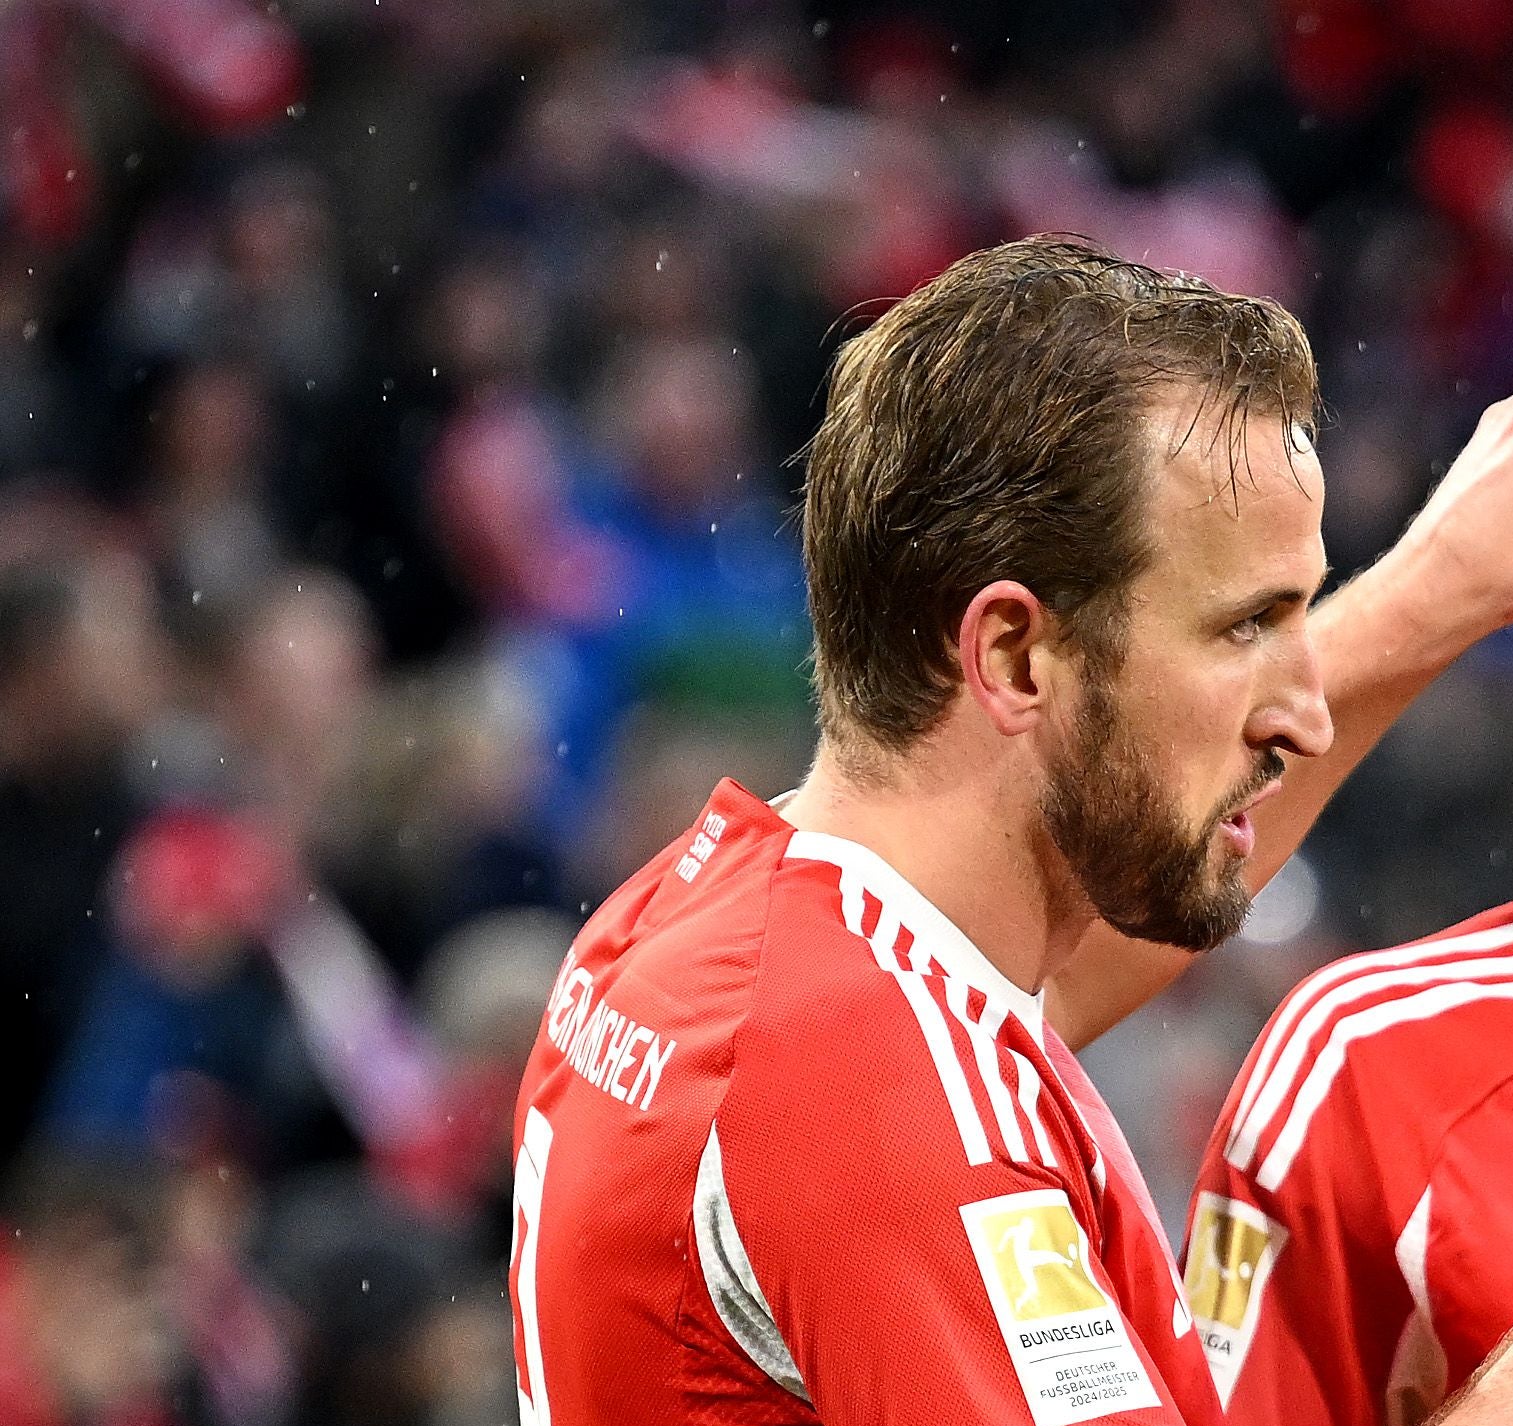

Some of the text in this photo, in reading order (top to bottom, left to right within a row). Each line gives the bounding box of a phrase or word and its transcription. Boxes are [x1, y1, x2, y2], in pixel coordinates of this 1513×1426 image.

[1019, 1319, 1115, 1348] BUNDESLIGA
[1055, 1361, 1118, 1382] DEUTSCHER
[1040, 1371, 1139, 1399] FUSSBALLMEISTER
[1069, 1386, 1127, 1408] 2024/2025
